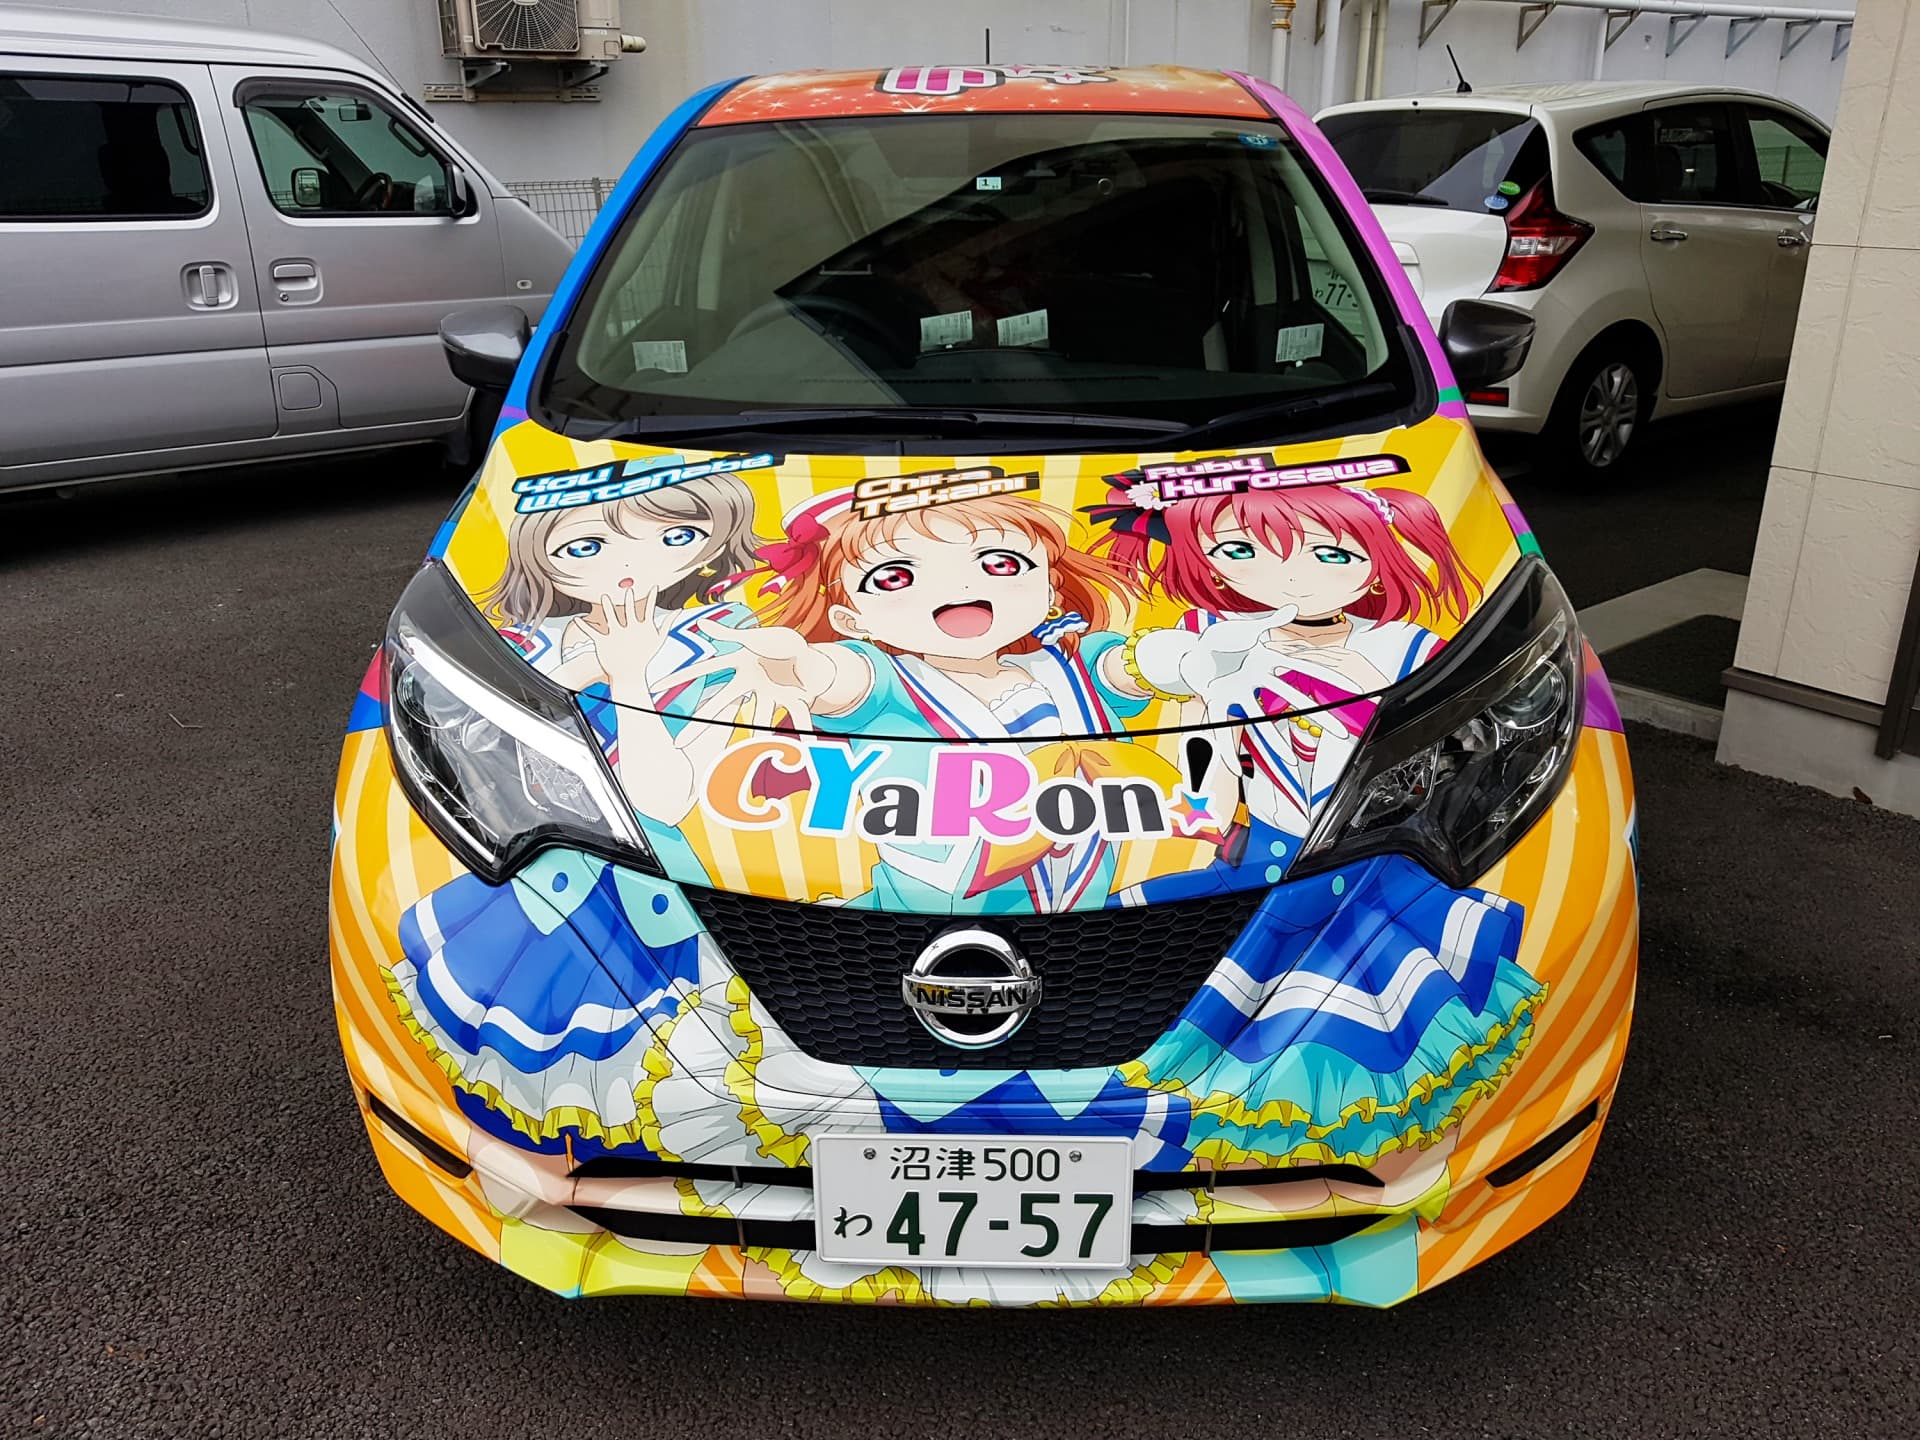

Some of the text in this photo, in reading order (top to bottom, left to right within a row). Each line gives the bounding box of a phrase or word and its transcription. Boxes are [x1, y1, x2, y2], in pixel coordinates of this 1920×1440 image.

[857, 469, 992, 499] Chika
[1145, 456, 1264, 481] Ruby
[1163, 459, 1399, 499] Kurosawa
[855, 476, 1027, 518] Takami
[705, 736, 1218, 837] CYaRon!
[916, 987, 1028, 1009] NISSAN
[833, 1191, 1114, 1258] わ 47-57
